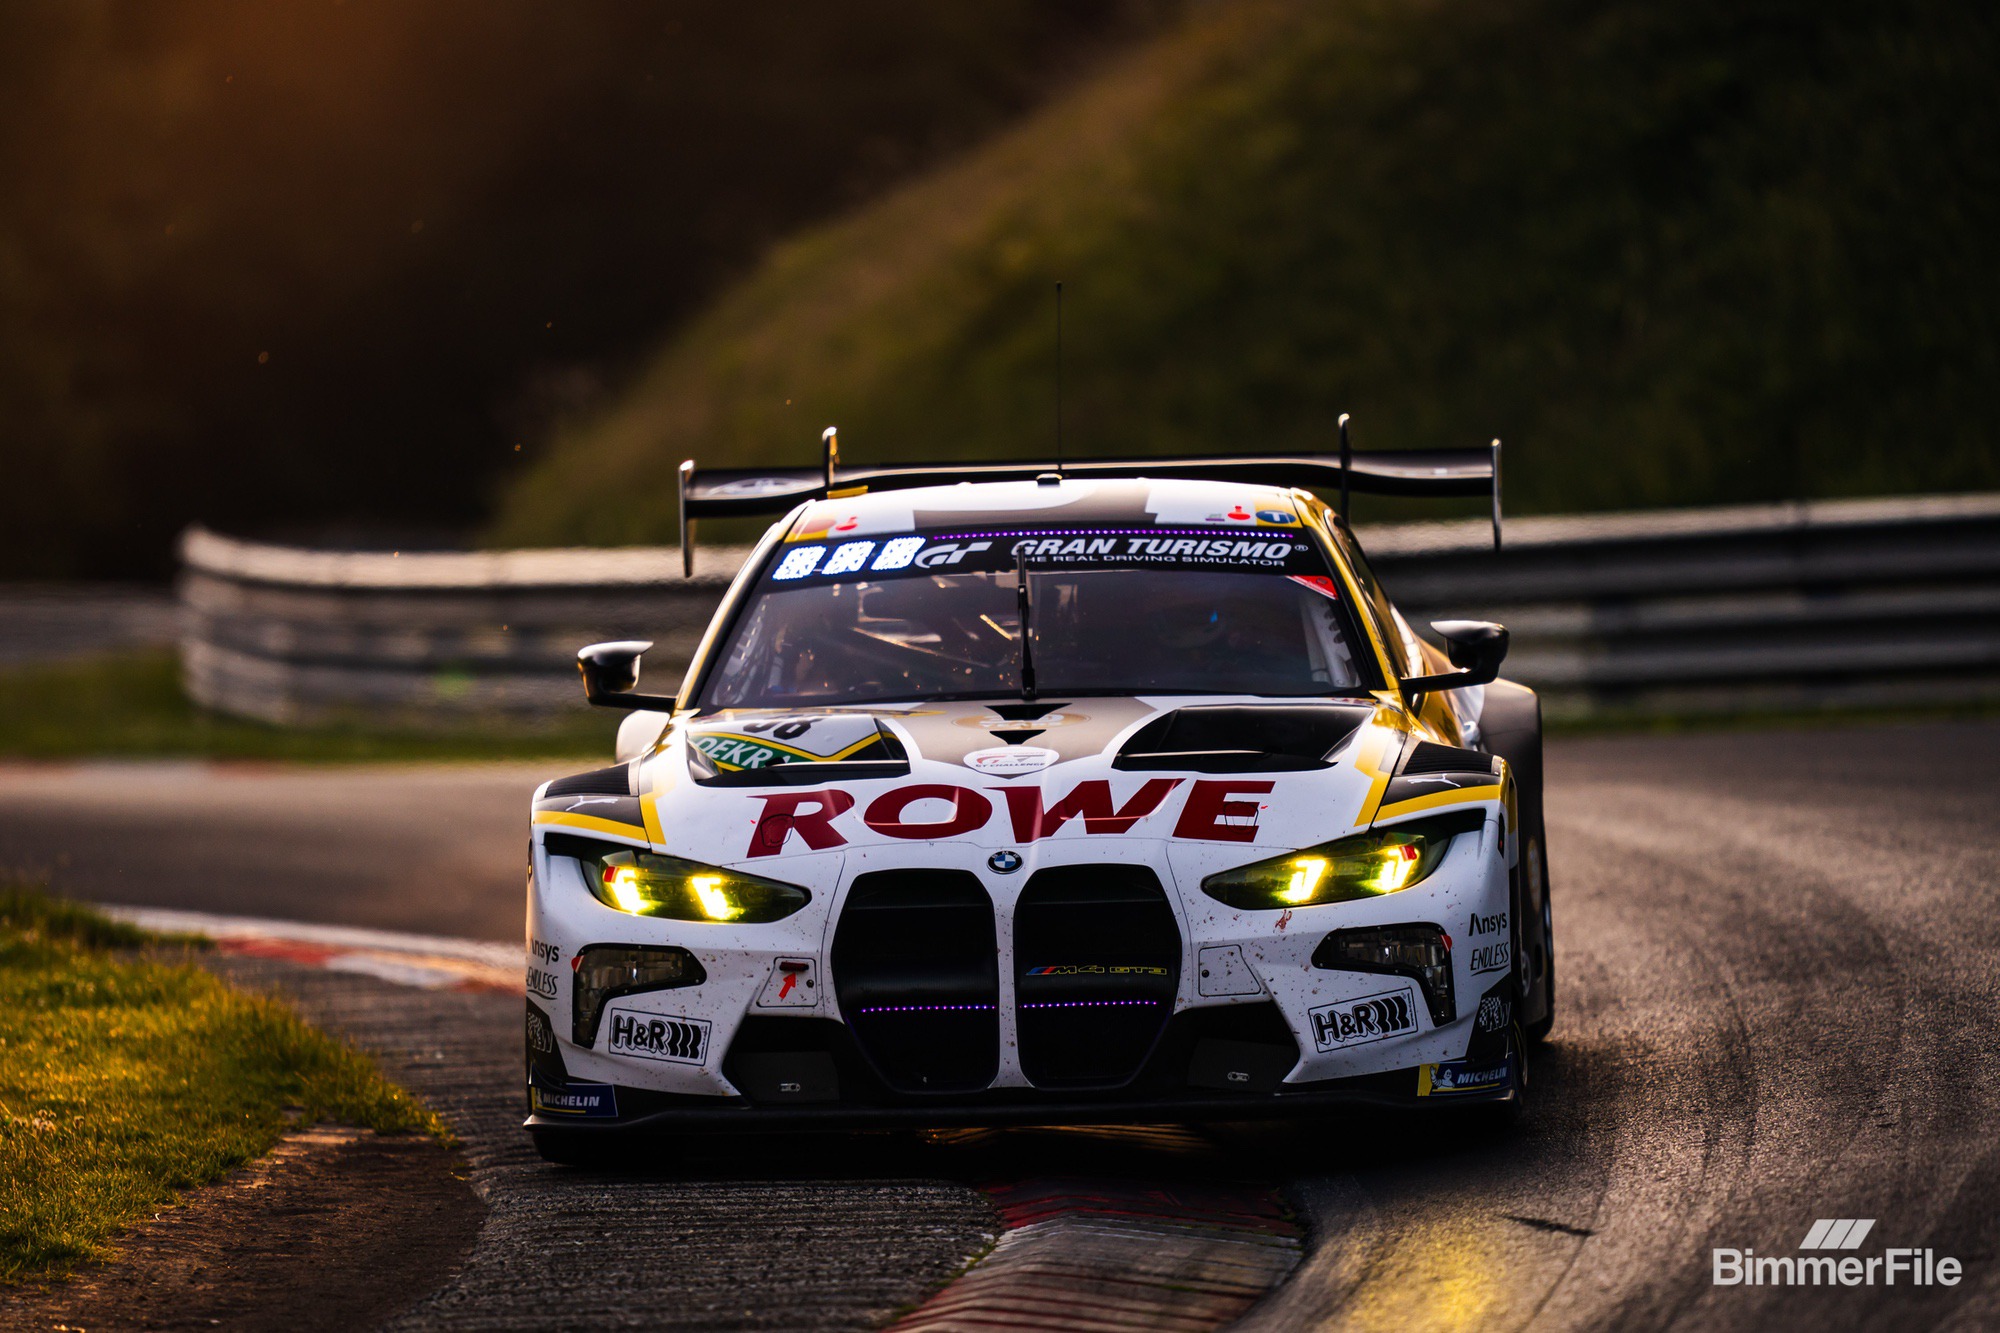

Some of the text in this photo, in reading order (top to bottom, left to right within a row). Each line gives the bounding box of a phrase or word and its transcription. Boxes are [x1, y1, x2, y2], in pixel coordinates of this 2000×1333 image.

[1011, 538, 1117, 556] GRAN
[1103, 555, 1176, 563] DRIVING
[1182, 556, 1285, 567] SIMULATOR
[695, 737, 791, 769] DEKR
[746, 778, 1276, 858] ROWE
[1468, 912, 1507, 936] Ansys
[1470, 941, 1509, 971] ENDLESS
[527, 966, 559, 996] ENDLESS
[1109, 966, 1168, 976] GT3
[612, 1015, 670, 1054] H&R
[1314, 1009, 1378, 1044] H&R
[1456, 1066, 1507, 1085] MICHELIN
[543, 1093, 600, 1107] MICHELIN
